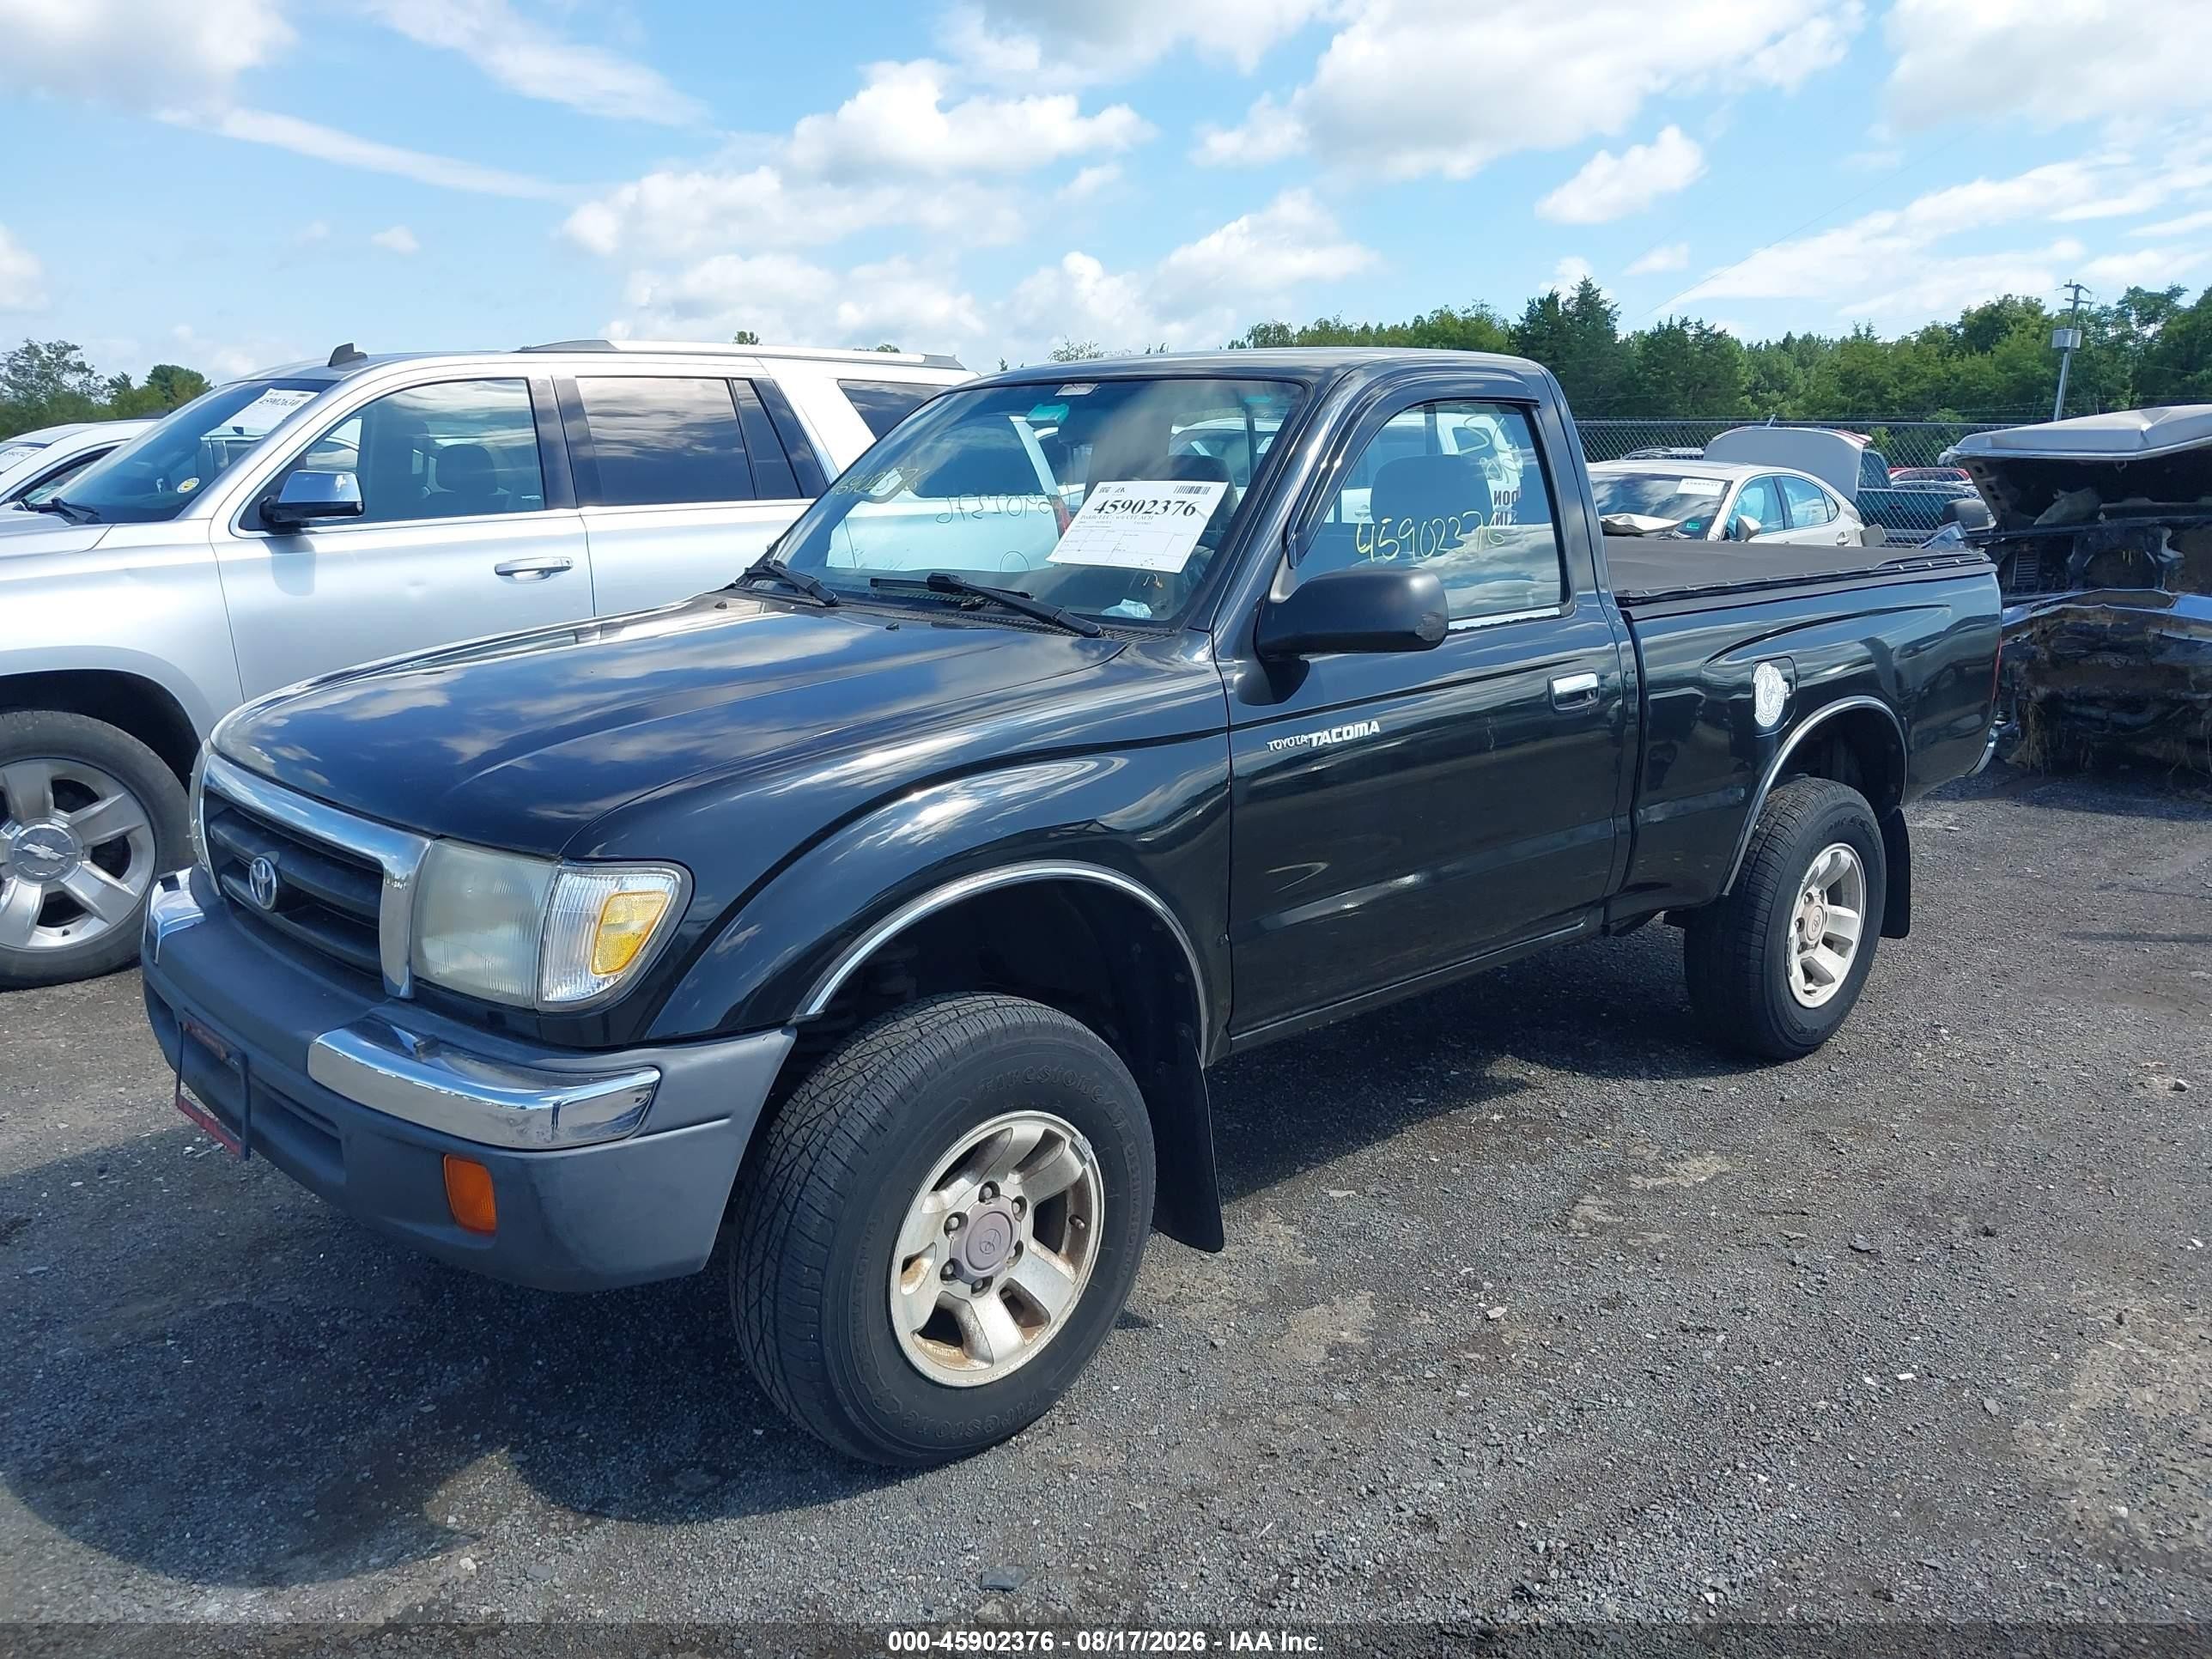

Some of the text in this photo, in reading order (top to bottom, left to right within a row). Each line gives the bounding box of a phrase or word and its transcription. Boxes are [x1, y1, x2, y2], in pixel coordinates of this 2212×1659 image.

[1094, 499, 1201, 516] 45902376
[1356, 511, 1505, 562] 45902376
[1267, 720, 1381, 751] TOYOTA TACOMA
